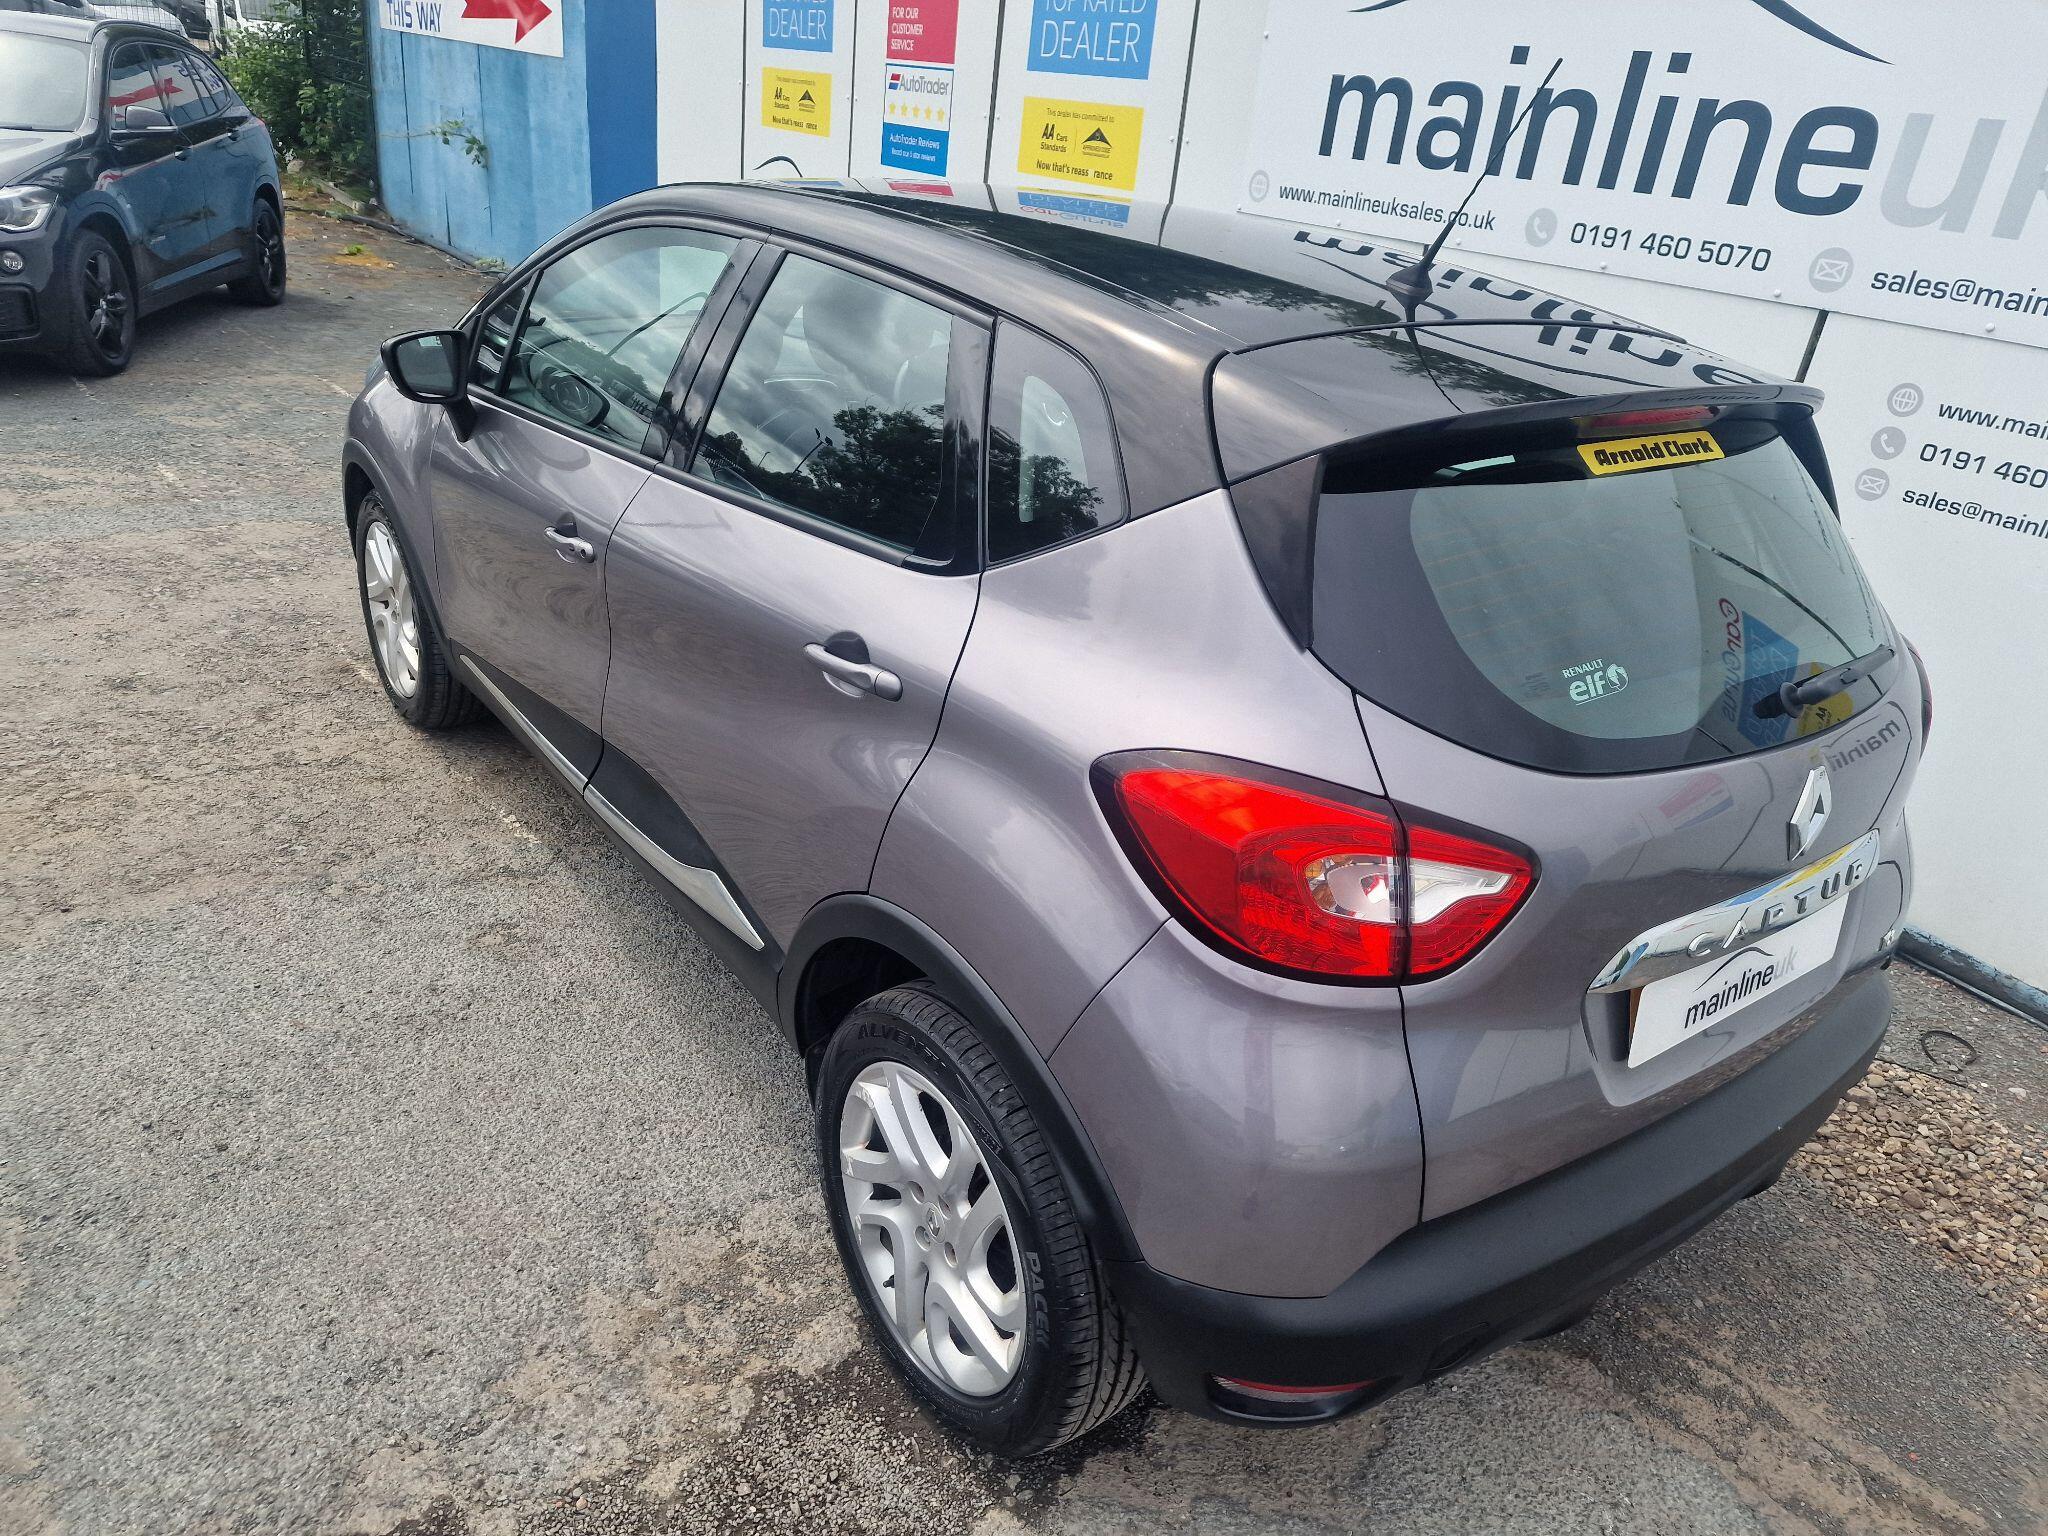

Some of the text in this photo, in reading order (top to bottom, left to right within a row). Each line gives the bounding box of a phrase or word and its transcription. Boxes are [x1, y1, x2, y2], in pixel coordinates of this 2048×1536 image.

[386, 0, 442, 33] THIS WAY
[769, 7, 827, 40] DEALER
[892, 6, 919, 19] FOR OUR
[890, 38, 915, 51] SERVICE
[892, 23, 924, 35] CUSTOMER
[1040, 20, 1141, 62] DEALER
[899, 73, 949, 96] AutoTrader
[918, 137, 940, 149] Reviews
[1040, 142, 1067, 152] Standards
[1041, 123, 1055, 140] AA
[1036, 159, 1051, 169] Now
[1052, 161, 1070, 173] that's
[1279, 184, 1496, 231] www.mainlineuksales.co.uk
[1570, 222, 1772, 272] 0191 460 5070
[1938, 403, 2048, 441] www.mai
[1593, 437, 1714, 467] Arnold Clark
[1919, 443, 2048, 489] 0191 460
[1902, 489, 2048, 540] sales@mainl
[1562, 658, 1605, 679] RENAULT
[1569, 670, 1606, 702] elf
[1687, 858, 1863, 958] CAPTUR
